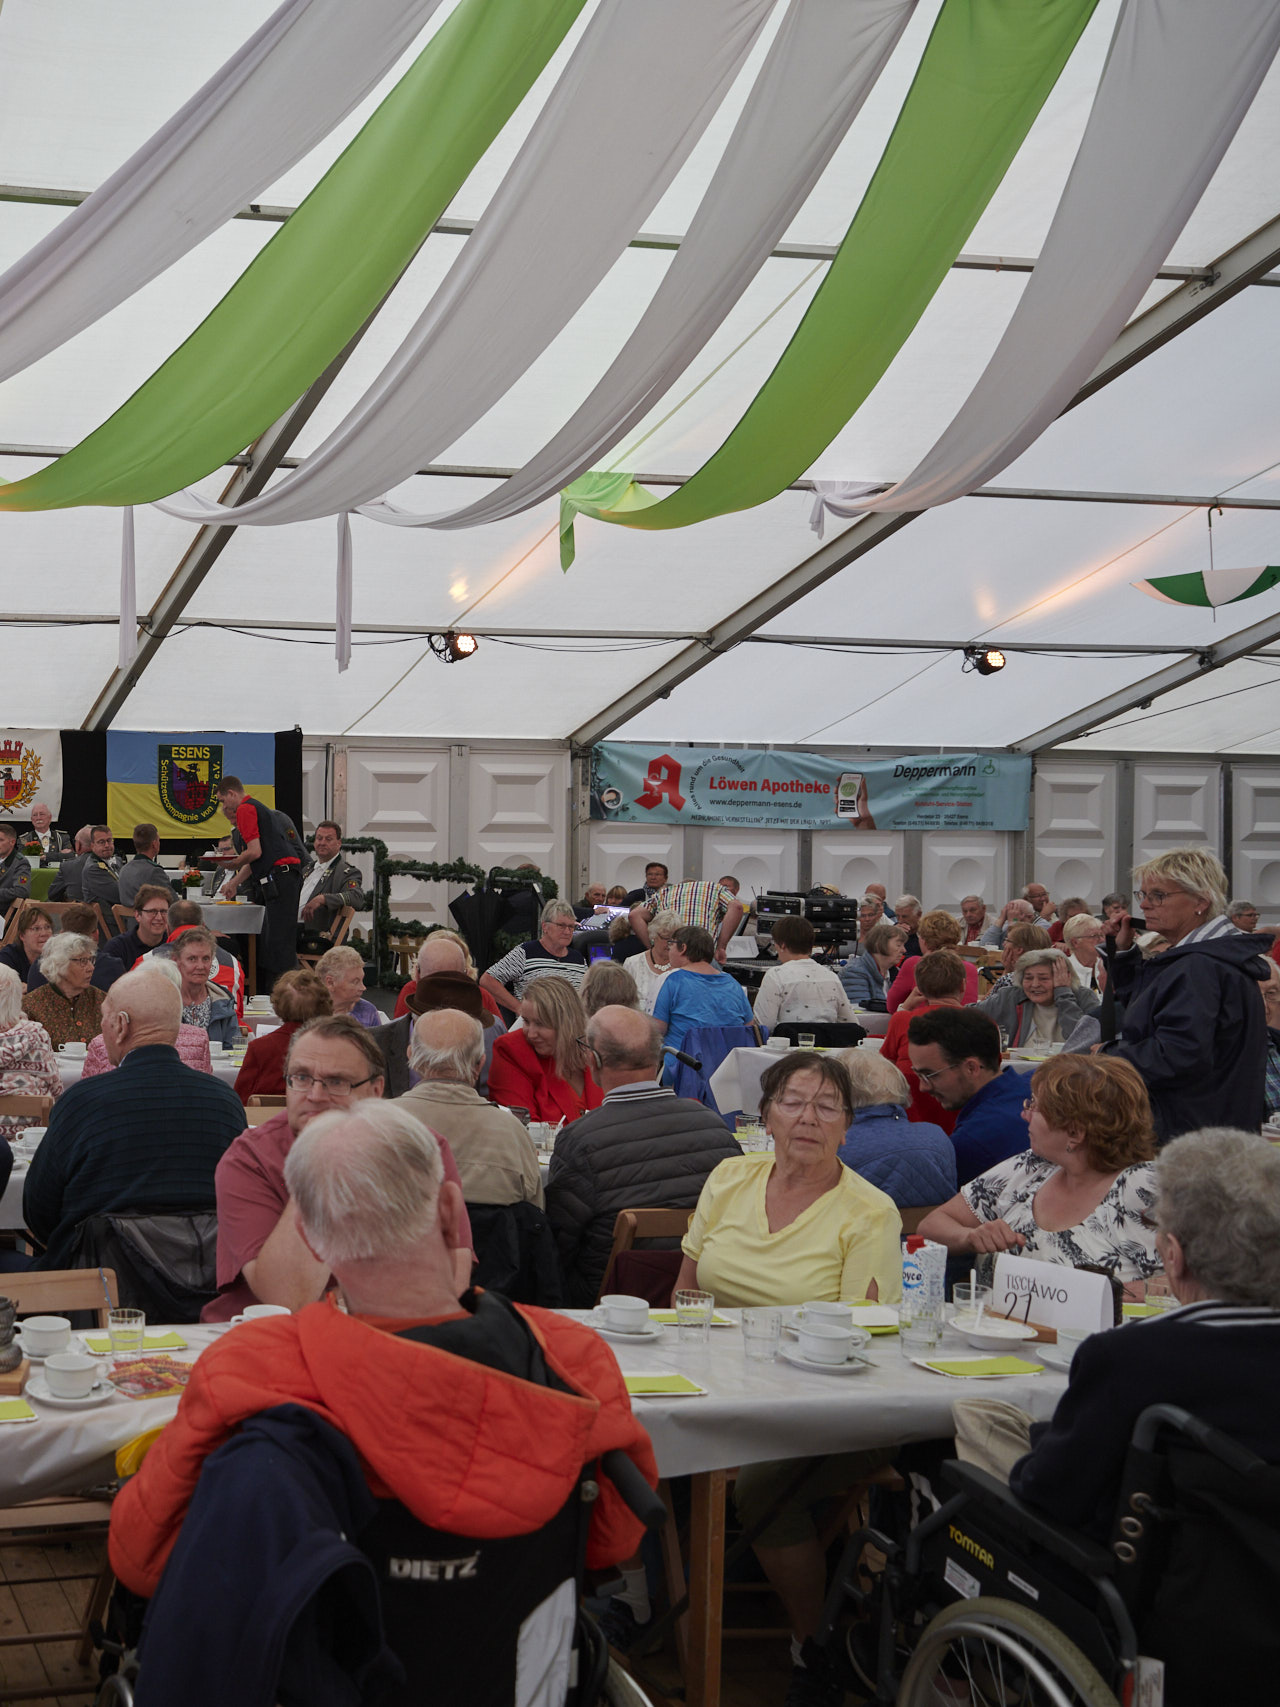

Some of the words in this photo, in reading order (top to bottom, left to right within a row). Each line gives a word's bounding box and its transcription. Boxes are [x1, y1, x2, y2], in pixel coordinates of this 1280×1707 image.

[171, 746, 211, 759] ESENS
[694, 765, 704, 776] um
[893, 764, 976, 781] Deppermann
[709, 776, 758, 791] Löwen
[761, 778, 831, 795] Apotheke
[709, 798, 802, 809] www.deppermann-esens.de
[201, 806, 214, 818] von
[902, 1271, 922, 1282] oyce
[1030, 1281, 1068, 1304] AWO
[1004, 1291, 1032, 1325] 27
[389, 1551, 481, 1581] DIETZ
